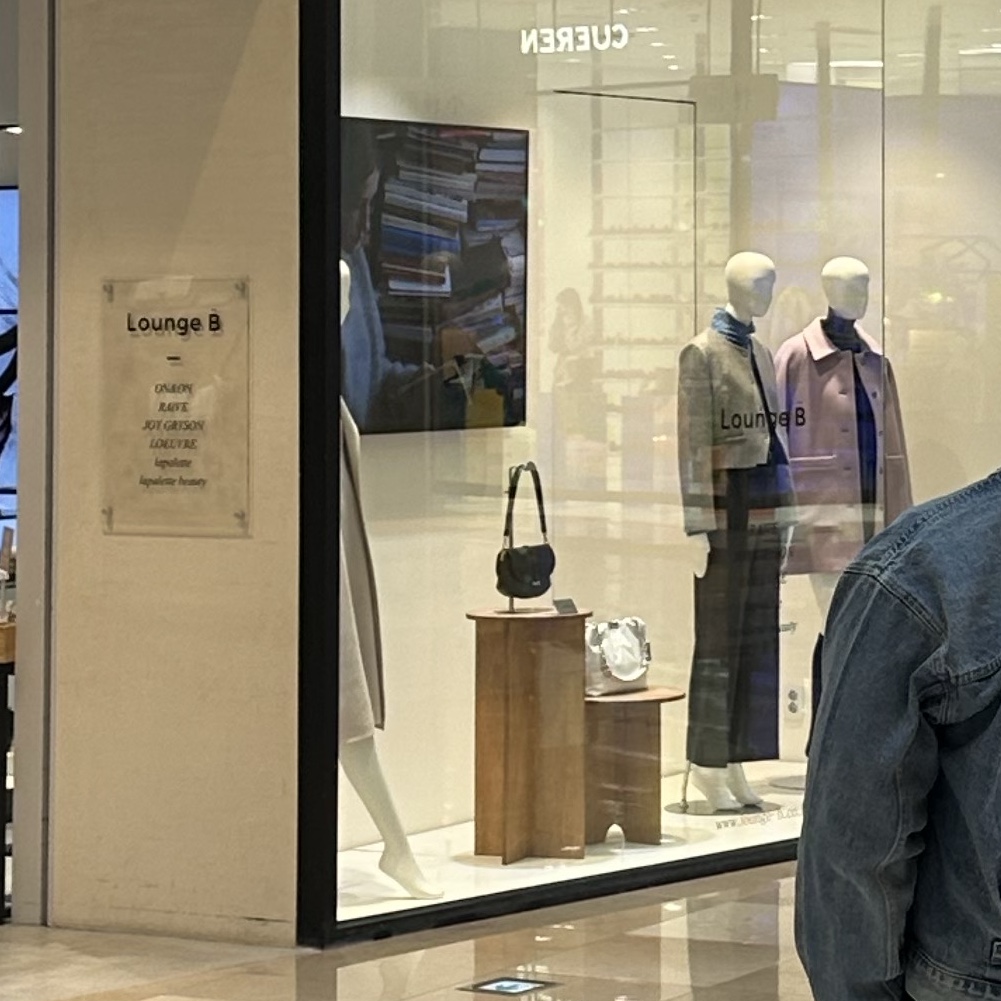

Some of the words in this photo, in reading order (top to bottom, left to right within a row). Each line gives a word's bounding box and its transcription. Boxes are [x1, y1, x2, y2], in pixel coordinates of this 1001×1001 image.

[127, 312, 201, 336] Lounge
[208, 313, 221, 331] B
[795, 406, 806, 427] B
